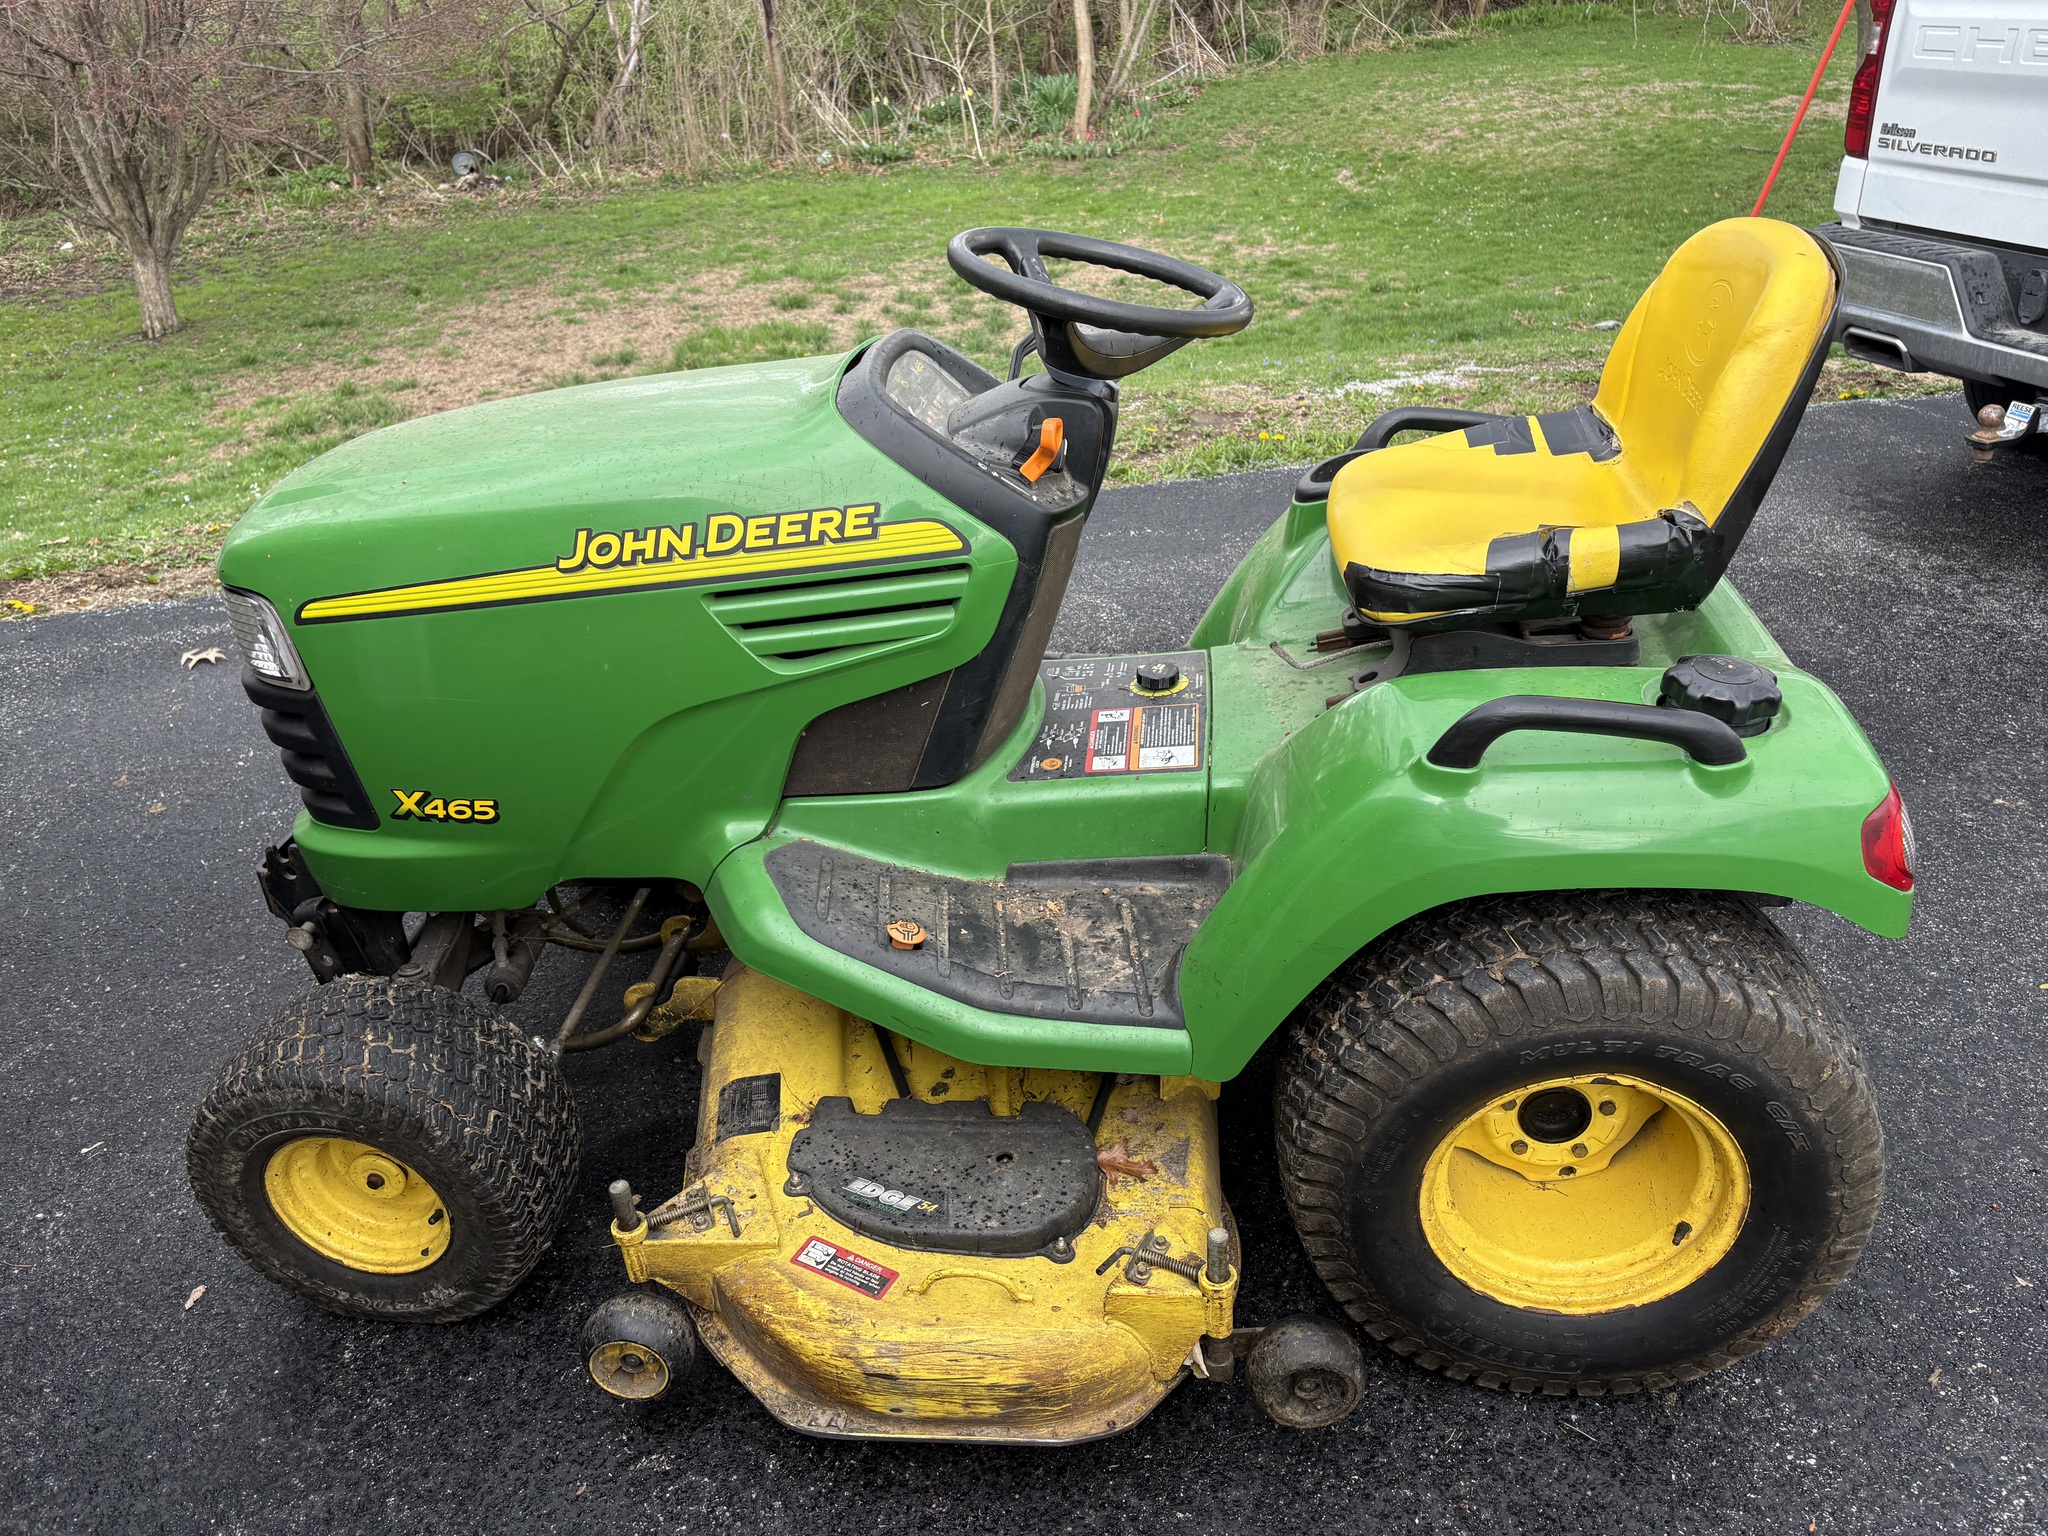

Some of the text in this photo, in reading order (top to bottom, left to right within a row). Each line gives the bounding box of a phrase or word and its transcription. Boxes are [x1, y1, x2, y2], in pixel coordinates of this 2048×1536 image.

[1878, 138, 1997, 163] SILVERADO
[2012, 402, 2033, 413] REESE
[556, 503, 880, 573] JOHN DEERE
[391, 789, 499, 822] X465
[1519, 1041, 1643, 1065] MULTI
[1655, 1045, 1757, 1091] TRAC
[842, 1177, 939, 1214] EDGE 54
[837, 1258, 881, 1280] ROTATING BLADE
[854, 1257, 883, 1272] DANGER
